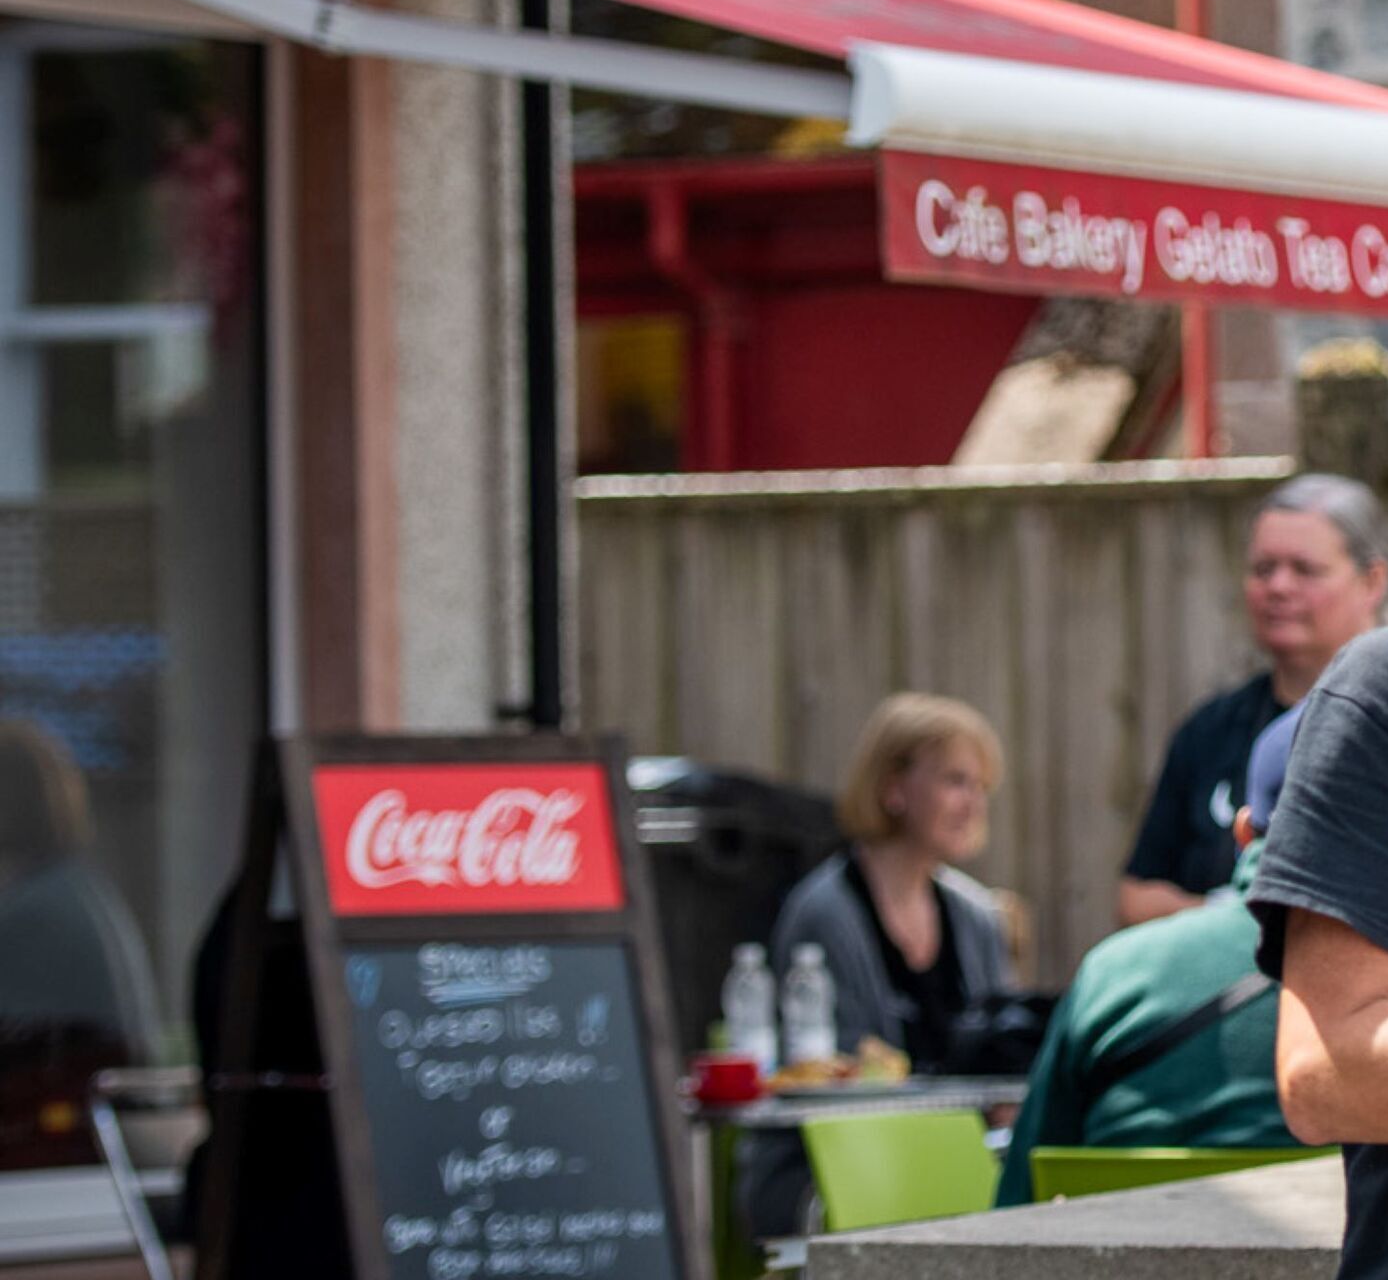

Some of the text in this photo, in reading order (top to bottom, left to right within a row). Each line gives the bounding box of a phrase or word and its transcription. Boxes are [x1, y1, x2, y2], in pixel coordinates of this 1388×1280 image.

[917, 181, 1009, 263] Cafe
[1013, 192, 1146, 295] Bakery
[1155, 205, 1277, 288] Gelato
[1277, 217, 1350, 293] Tea
[345, 789, 586, 888] Coca-Cola
